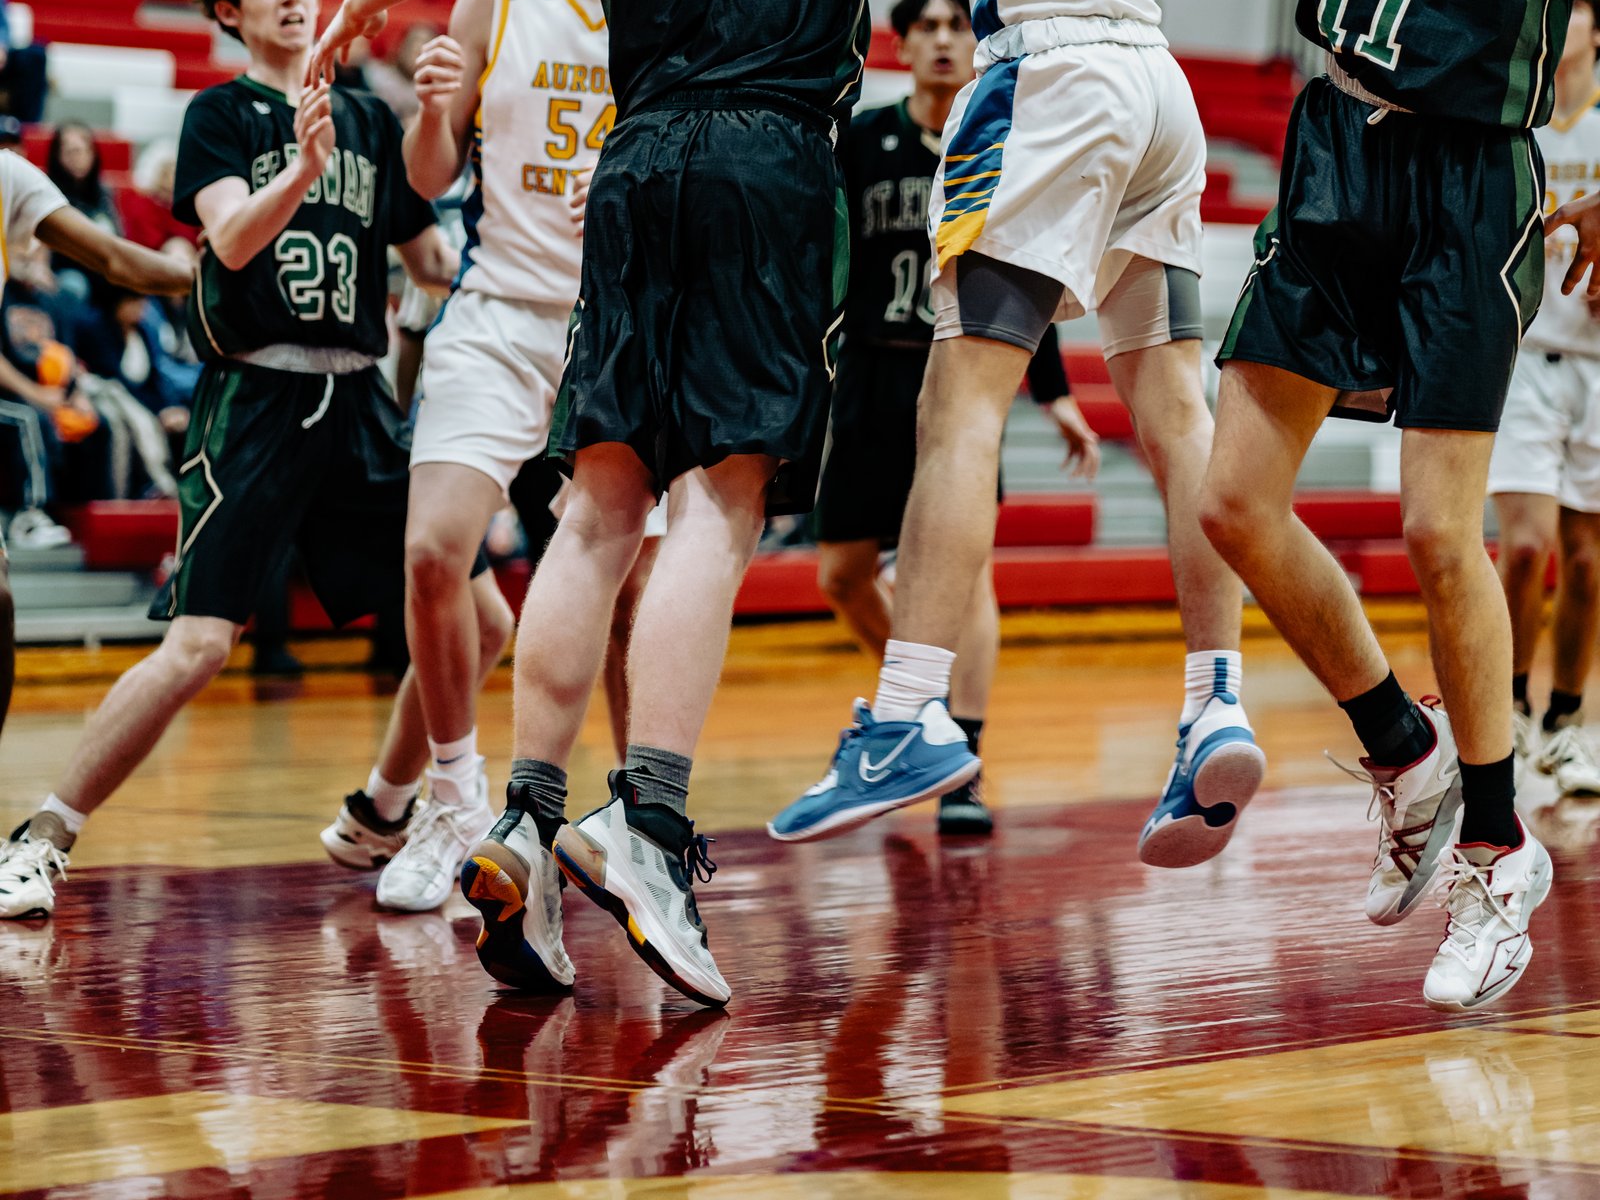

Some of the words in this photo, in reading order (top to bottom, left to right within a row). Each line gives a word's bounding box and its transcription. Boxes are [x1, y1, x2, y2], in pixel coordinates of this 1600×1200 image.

[545, 98, 618, 161] 54
[521, 163, 586, 196] CEN
[275, 230, 358, 324] 23
